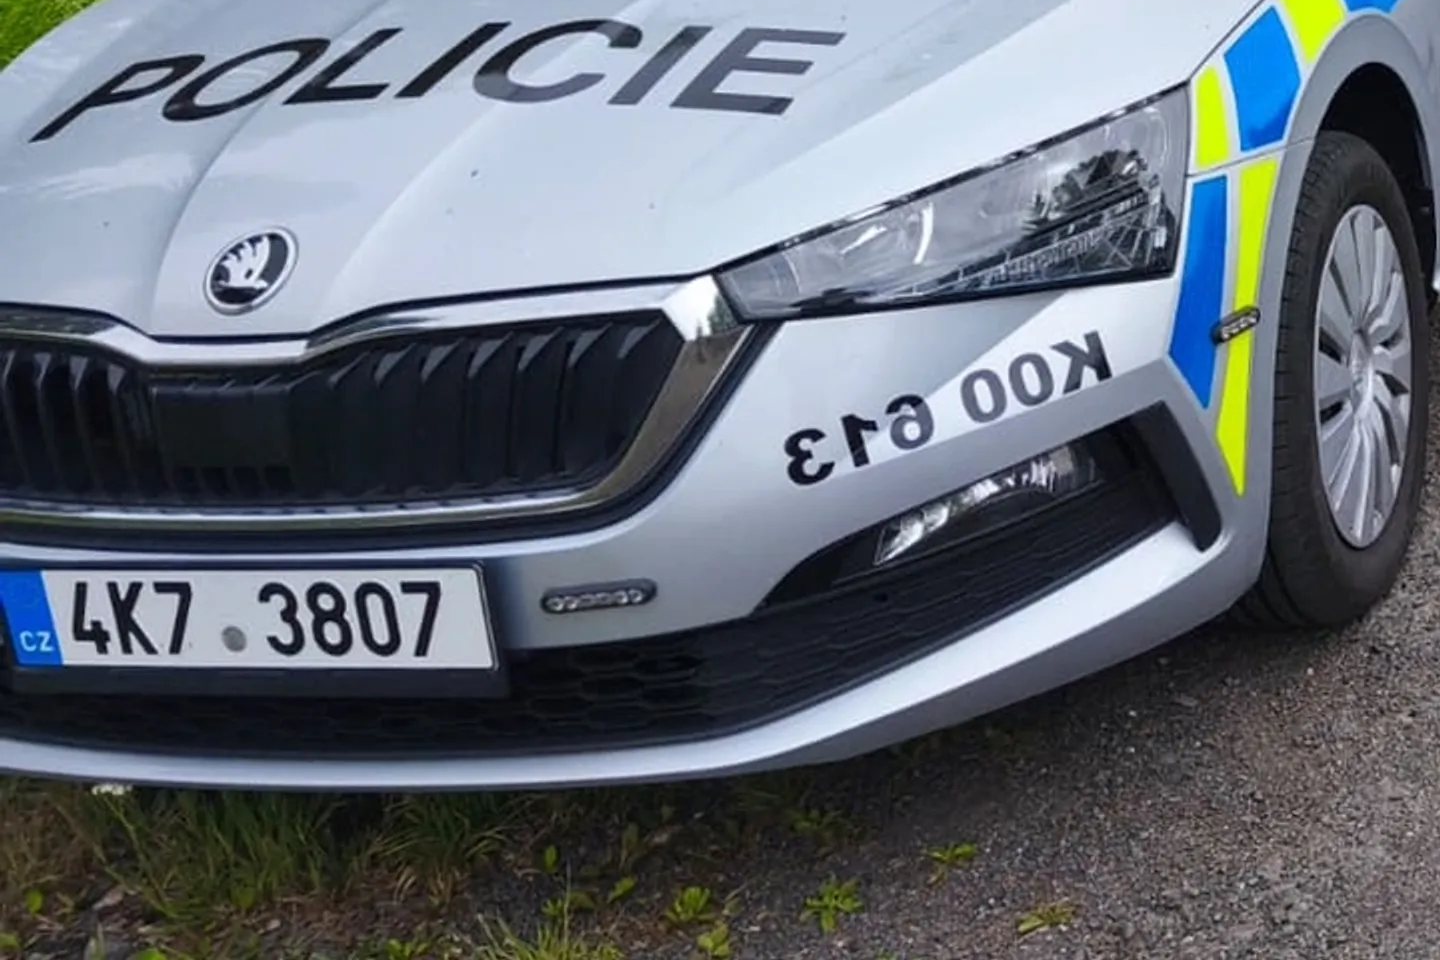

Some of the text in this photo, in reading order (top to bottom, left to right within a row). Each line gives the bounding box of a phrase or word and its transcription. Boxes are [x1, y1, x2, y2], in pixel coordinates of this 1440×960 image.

[28, 19, 847, 143] POLICIE
[19, 631, 55, 653] CZ
[71, 581, 443, 657] 4K7 3807
